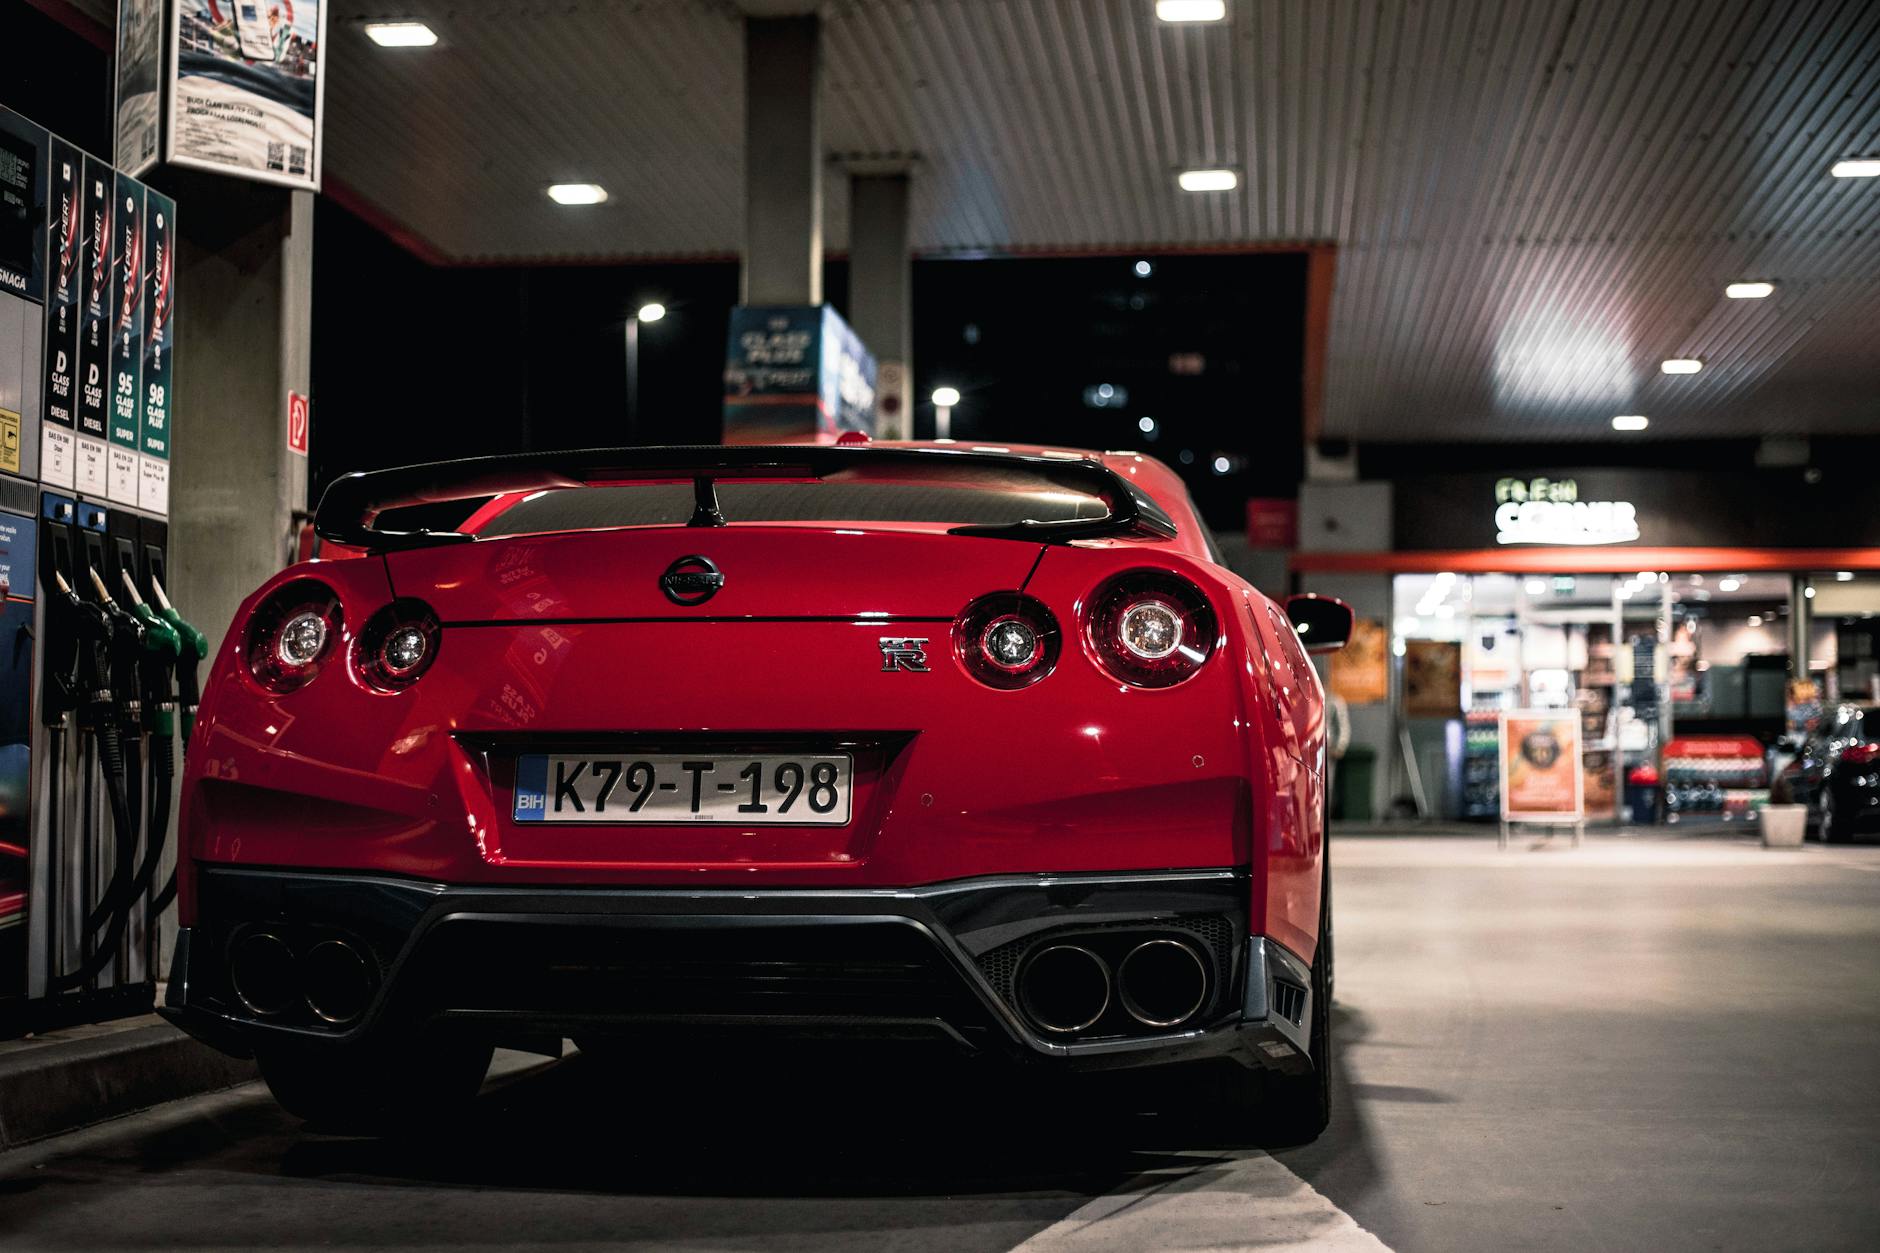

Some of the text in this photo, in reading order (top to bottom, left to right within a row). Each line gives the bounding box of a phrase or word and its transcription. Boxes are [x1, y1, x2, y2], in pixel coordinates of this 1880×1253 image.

[56, 350, 67, 373] D
[52, 372, 70, 387] CLASS
[88, 363, 99, 385] D
[53, 383, 68, 397] PLUS
[84, 384, 102, 399] CLASS
[118, 372, 133, 396] 95
[86, 395, 100, 408] PLUS
[115, 394, 134, 408] CLASS
[149, 383, 165, 407] 98
[51, 406, 70, 421] DIESEL
[117, 404, 132, 419] PLUS
[147, 405, 165, 421] CLASS
[84, 416, 102, 432] DIESEL
[148, 415, 164, 429] PLUS
[116, 427, 134, 441] SUPER
[147, 437, 165, 451] SUPER
[554, 761, 839, 814] K79-T-198
[518, 794, 545, 809] BIH
